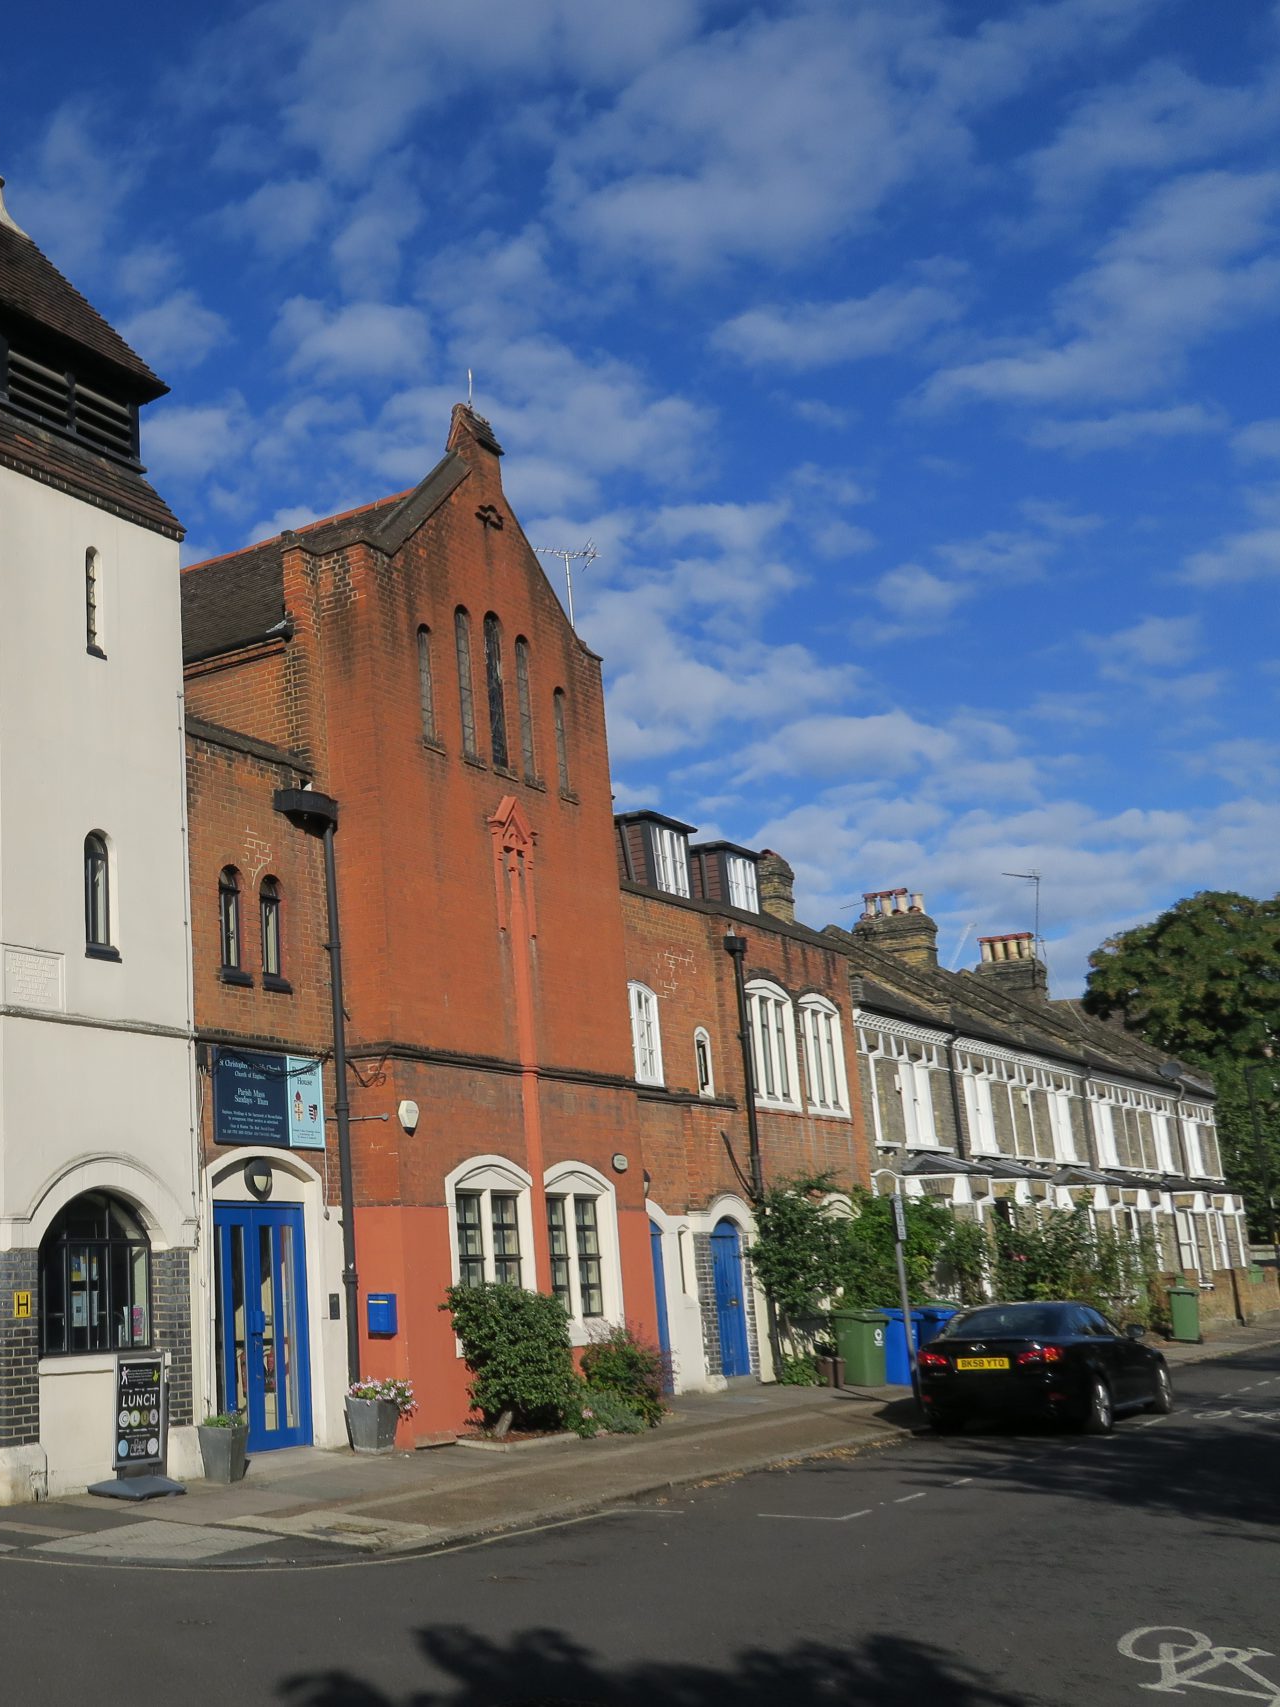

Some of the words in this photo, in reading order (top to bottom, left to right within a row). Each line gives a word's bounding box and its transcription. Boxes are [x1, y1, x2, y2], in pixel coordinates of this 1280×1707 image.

[297, 1077, 313, 1086] House
[238, 1087, 252, 1096] Parish
[253, 1089, 266, 1098] Mass
[234, 1094, 253, 1105] Sundays
[17, 1294, 29, 1316] H
[122, 1393, 156, 1407] LUNCH
